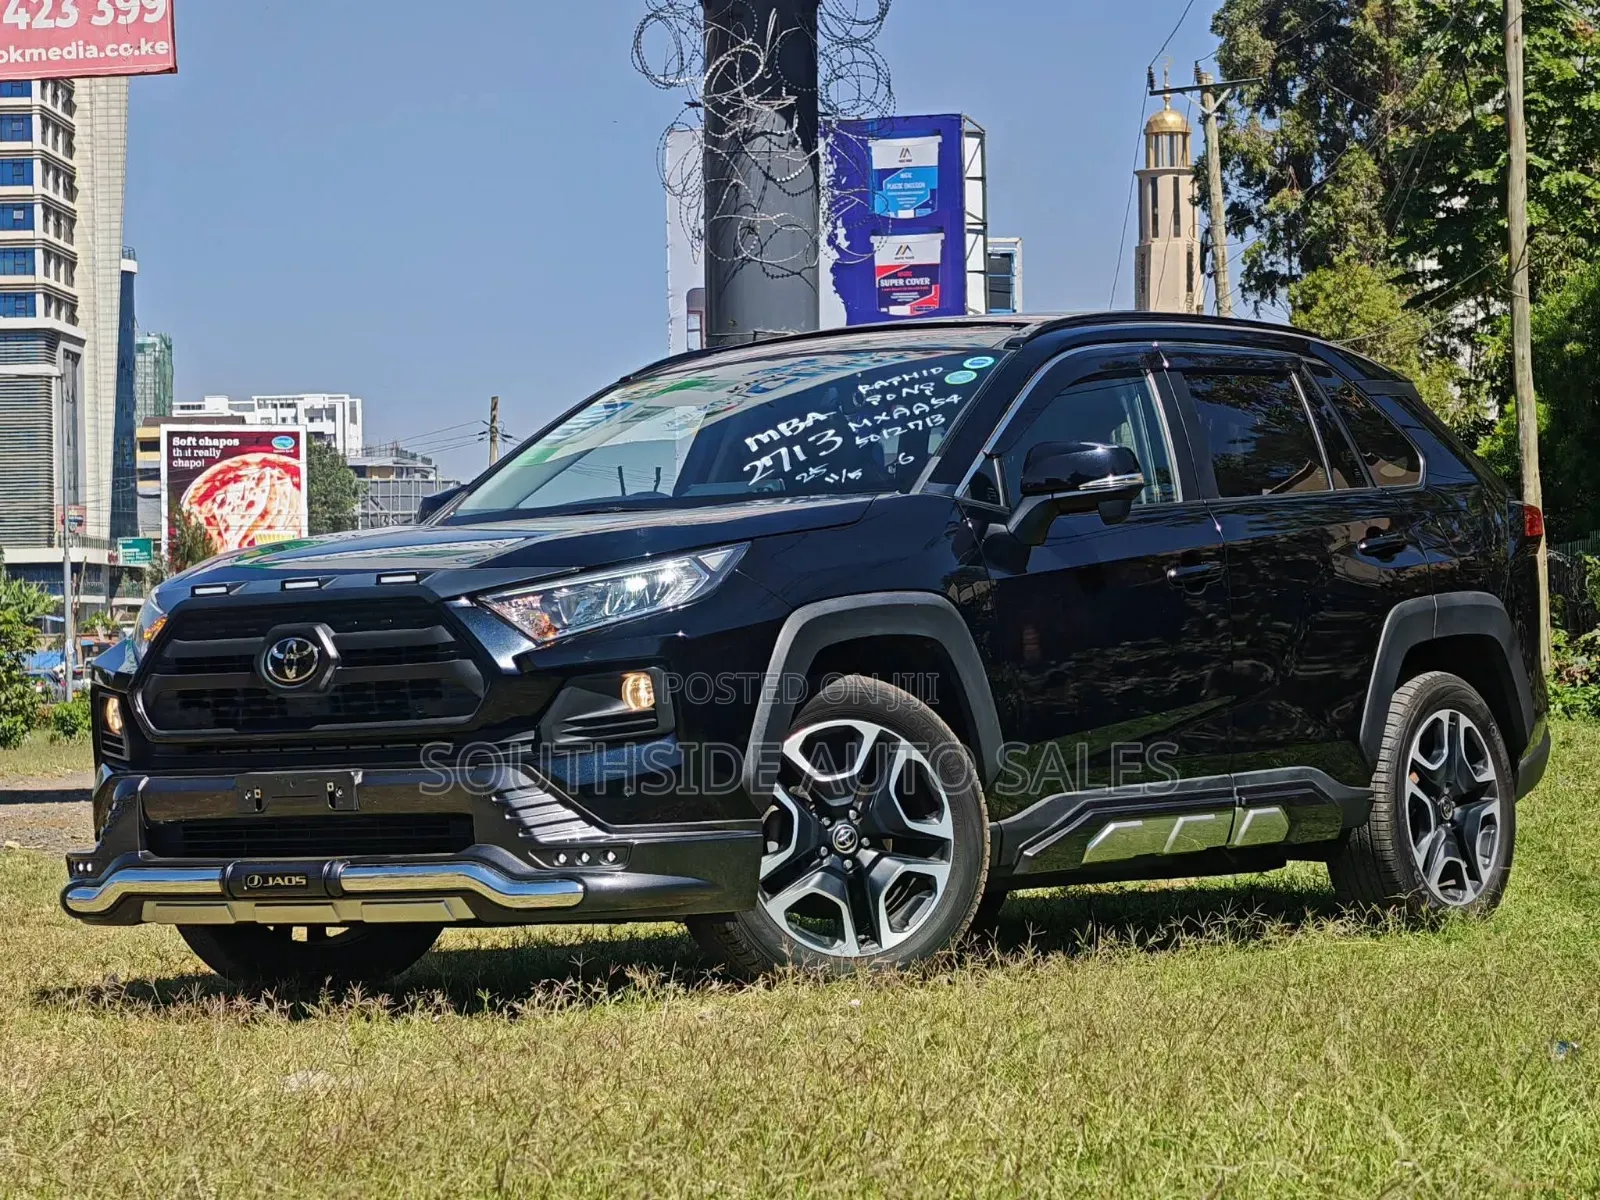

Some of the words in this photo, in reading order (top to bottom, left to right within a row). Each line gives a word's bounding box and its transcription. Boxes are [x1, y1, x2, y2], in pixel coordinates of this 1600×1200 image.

[880, 279, 904, 287] SUPER
[905, 278, 930, 286] COVER
[172, 437, 197, 446] Soft
[198, 437, 240, 448] chapos
[193, 448, 222, 459] really
[743, 429, 843, 486] 2713
[172, 458, 205, 470] chapo!
[263, 875, 307, 887] JAOS
